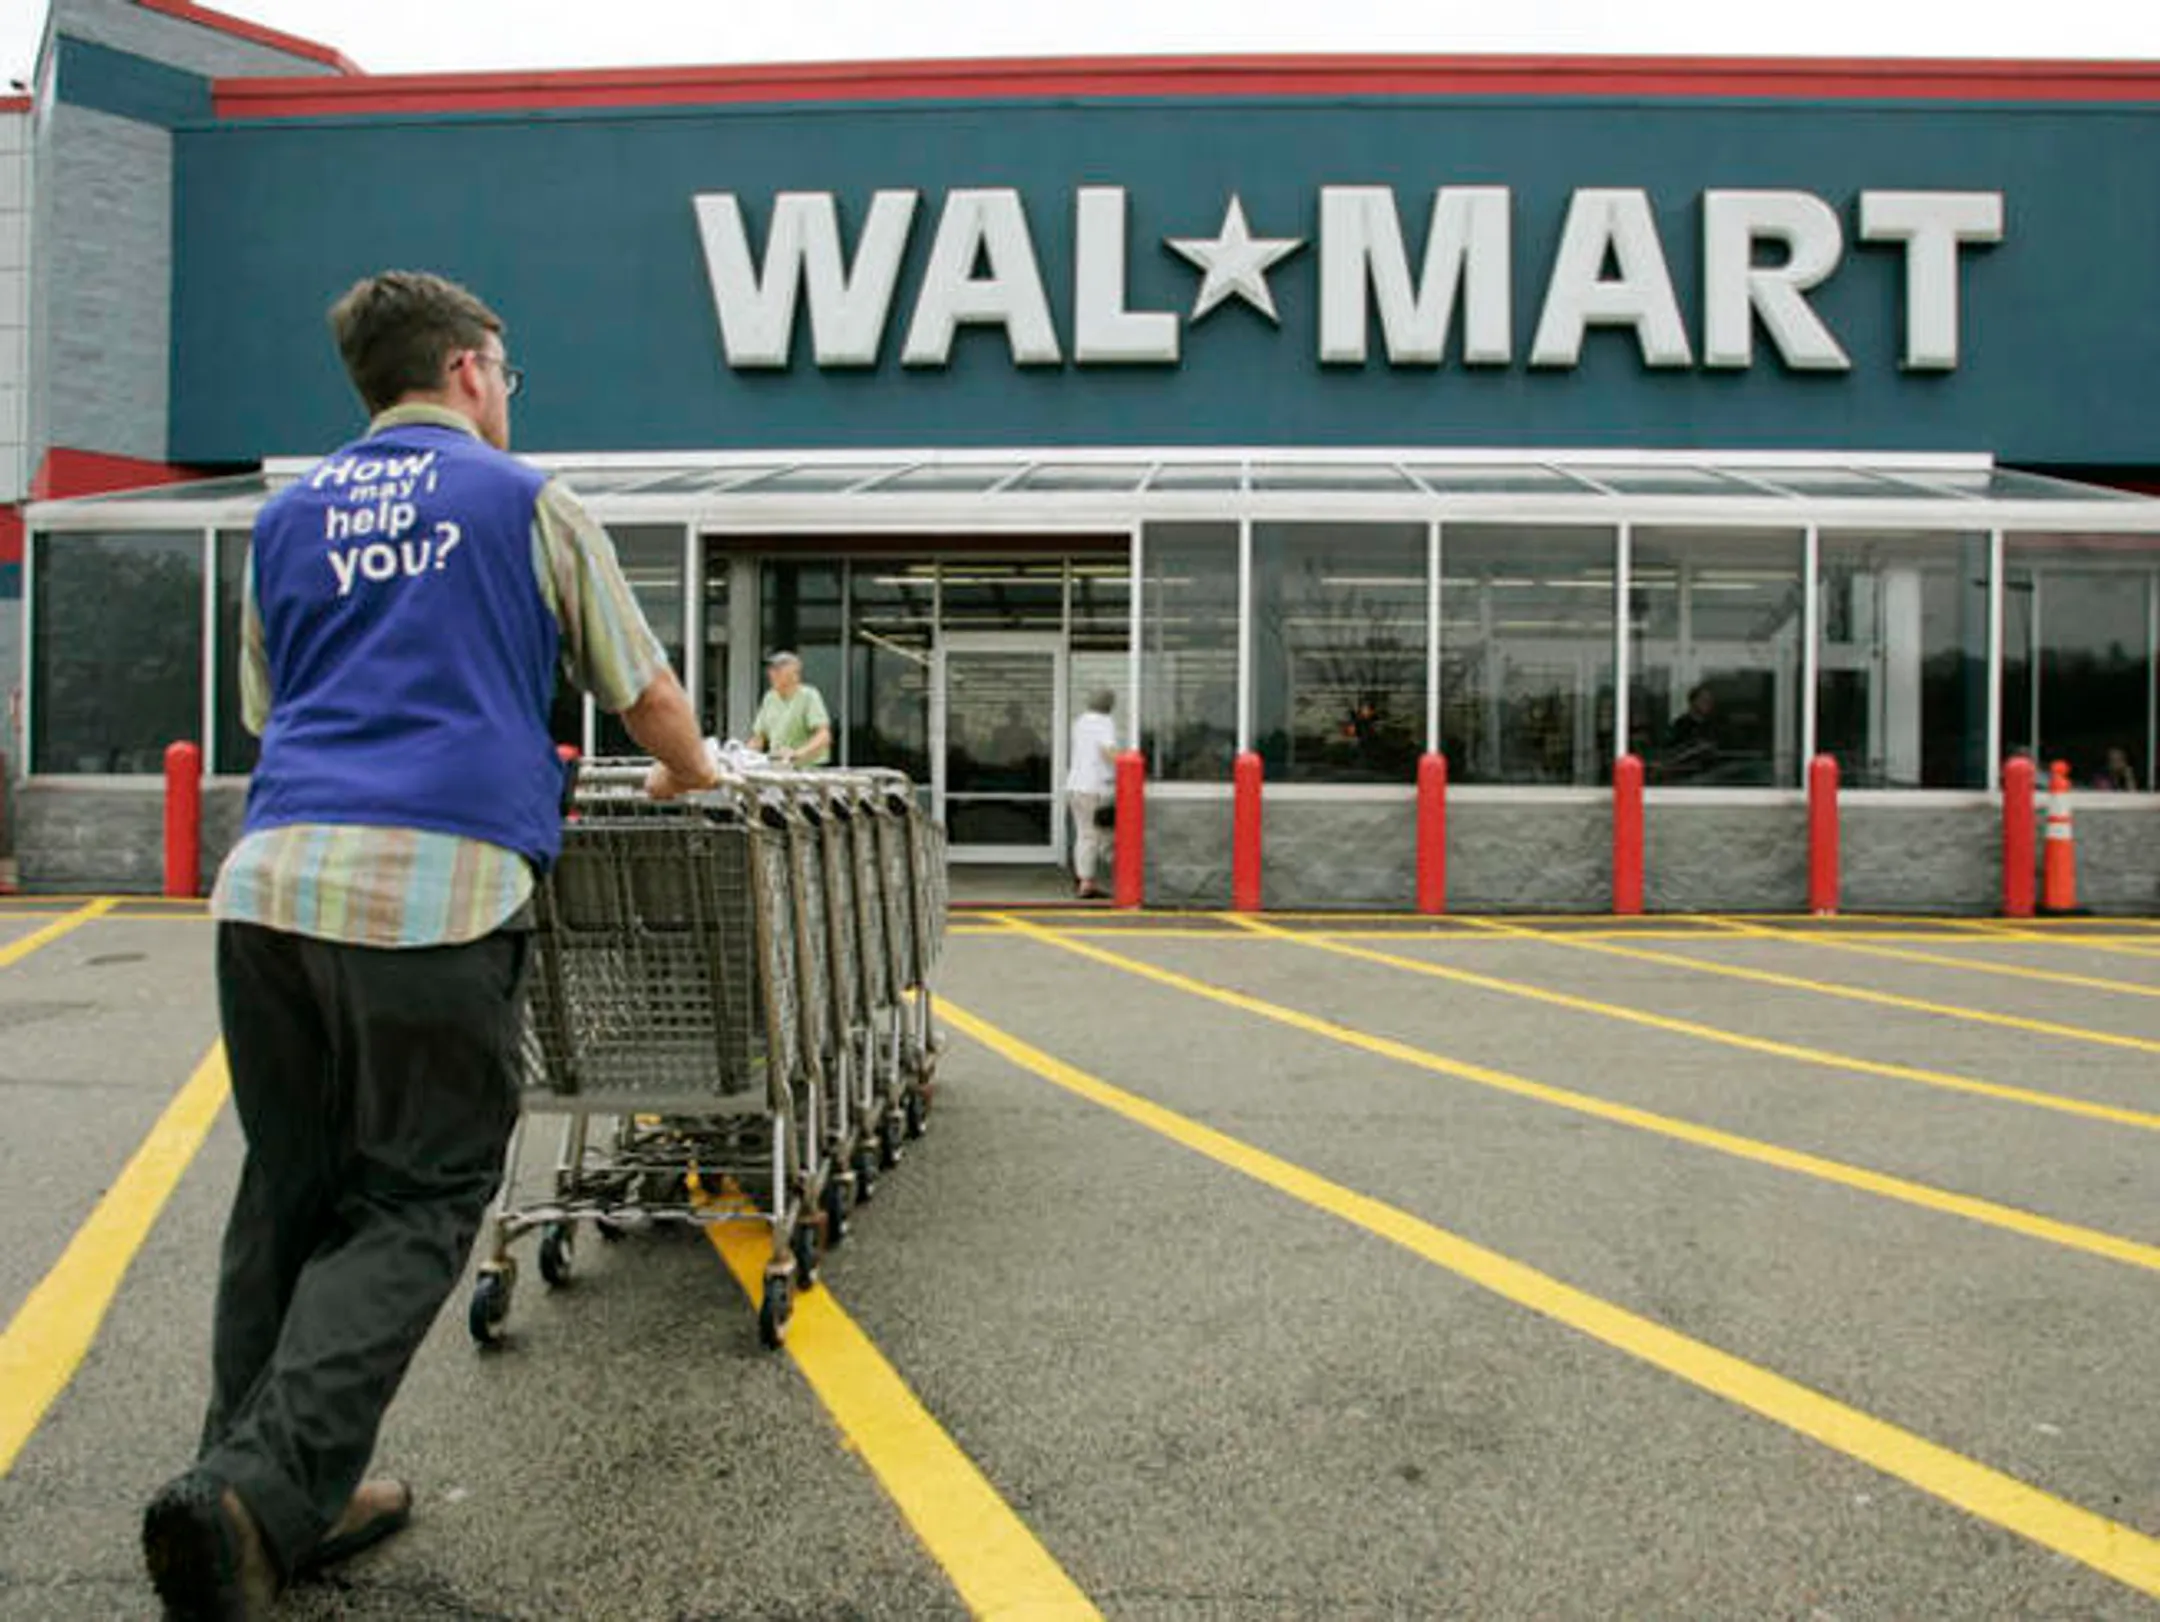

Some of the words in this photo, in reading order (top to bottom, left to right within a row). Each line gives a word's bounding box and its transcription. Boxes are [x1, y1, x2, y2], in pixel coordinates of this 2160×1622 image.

[693, 186, 1180, 367] WAL
[1318, 186, 2003, 370] MART
[311, 450, 435, 489] How
[350, 478, 415, 502] may
[326, 501, 416, 540] help
[328, 522, 461, 596] you?
